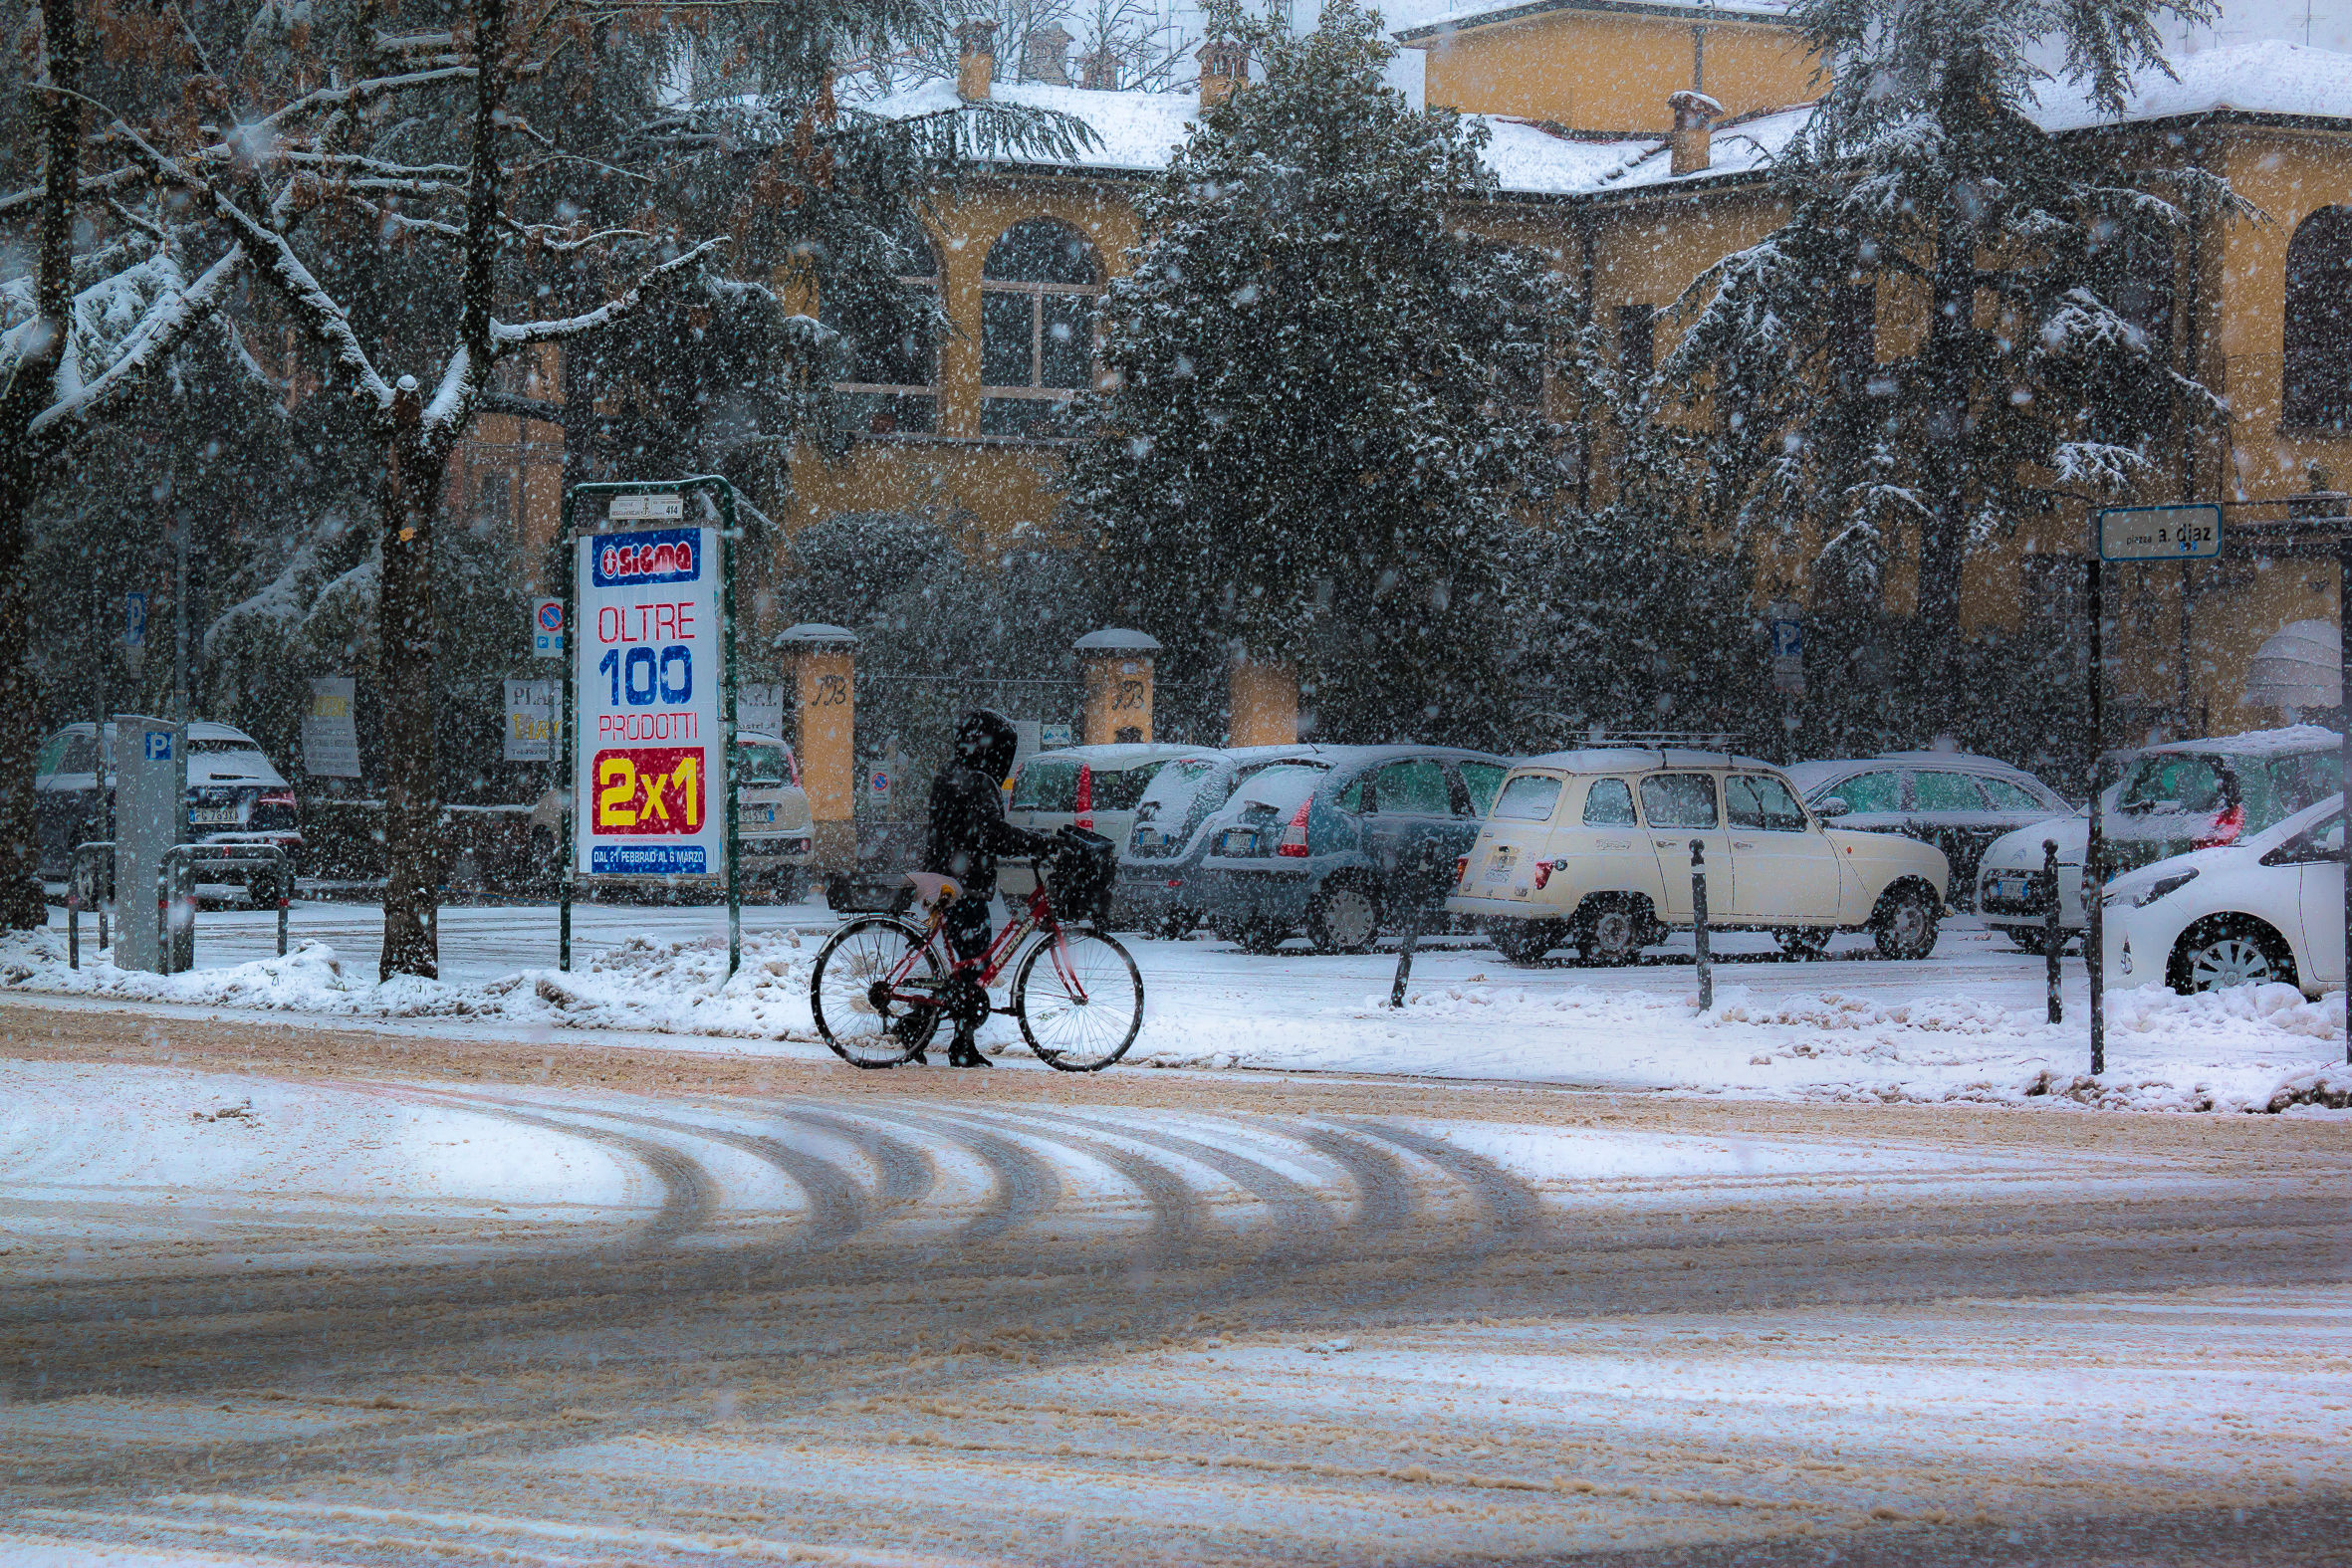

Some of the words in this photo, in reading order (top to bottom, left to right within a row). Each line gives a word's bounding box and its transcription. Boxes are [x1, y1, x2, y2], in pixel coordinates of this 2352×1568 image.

[666, 505, 678, 515] 414
[2127, 535, 2152, 546] piazza
[2158, 528, 2171, 543] a.
[2177, 524, 2212, 543] diaz
[598, 601, 695, 644] OLTRE
[1778, 624, 1796, 653] P
[599, 645, 693, 706] 100
[599, 712, 698, 742] PRODOTTI
[150, 735, 167, 759] P
[599, 758, 697, 826] 2x1
[593, 850, 608, 863] DAL
[610, 850, 619, 863] 21
[657, 850, 668, 863] AL
[669, 850, 675, 863] 6
[677, 850, 704, 863] MARZO
